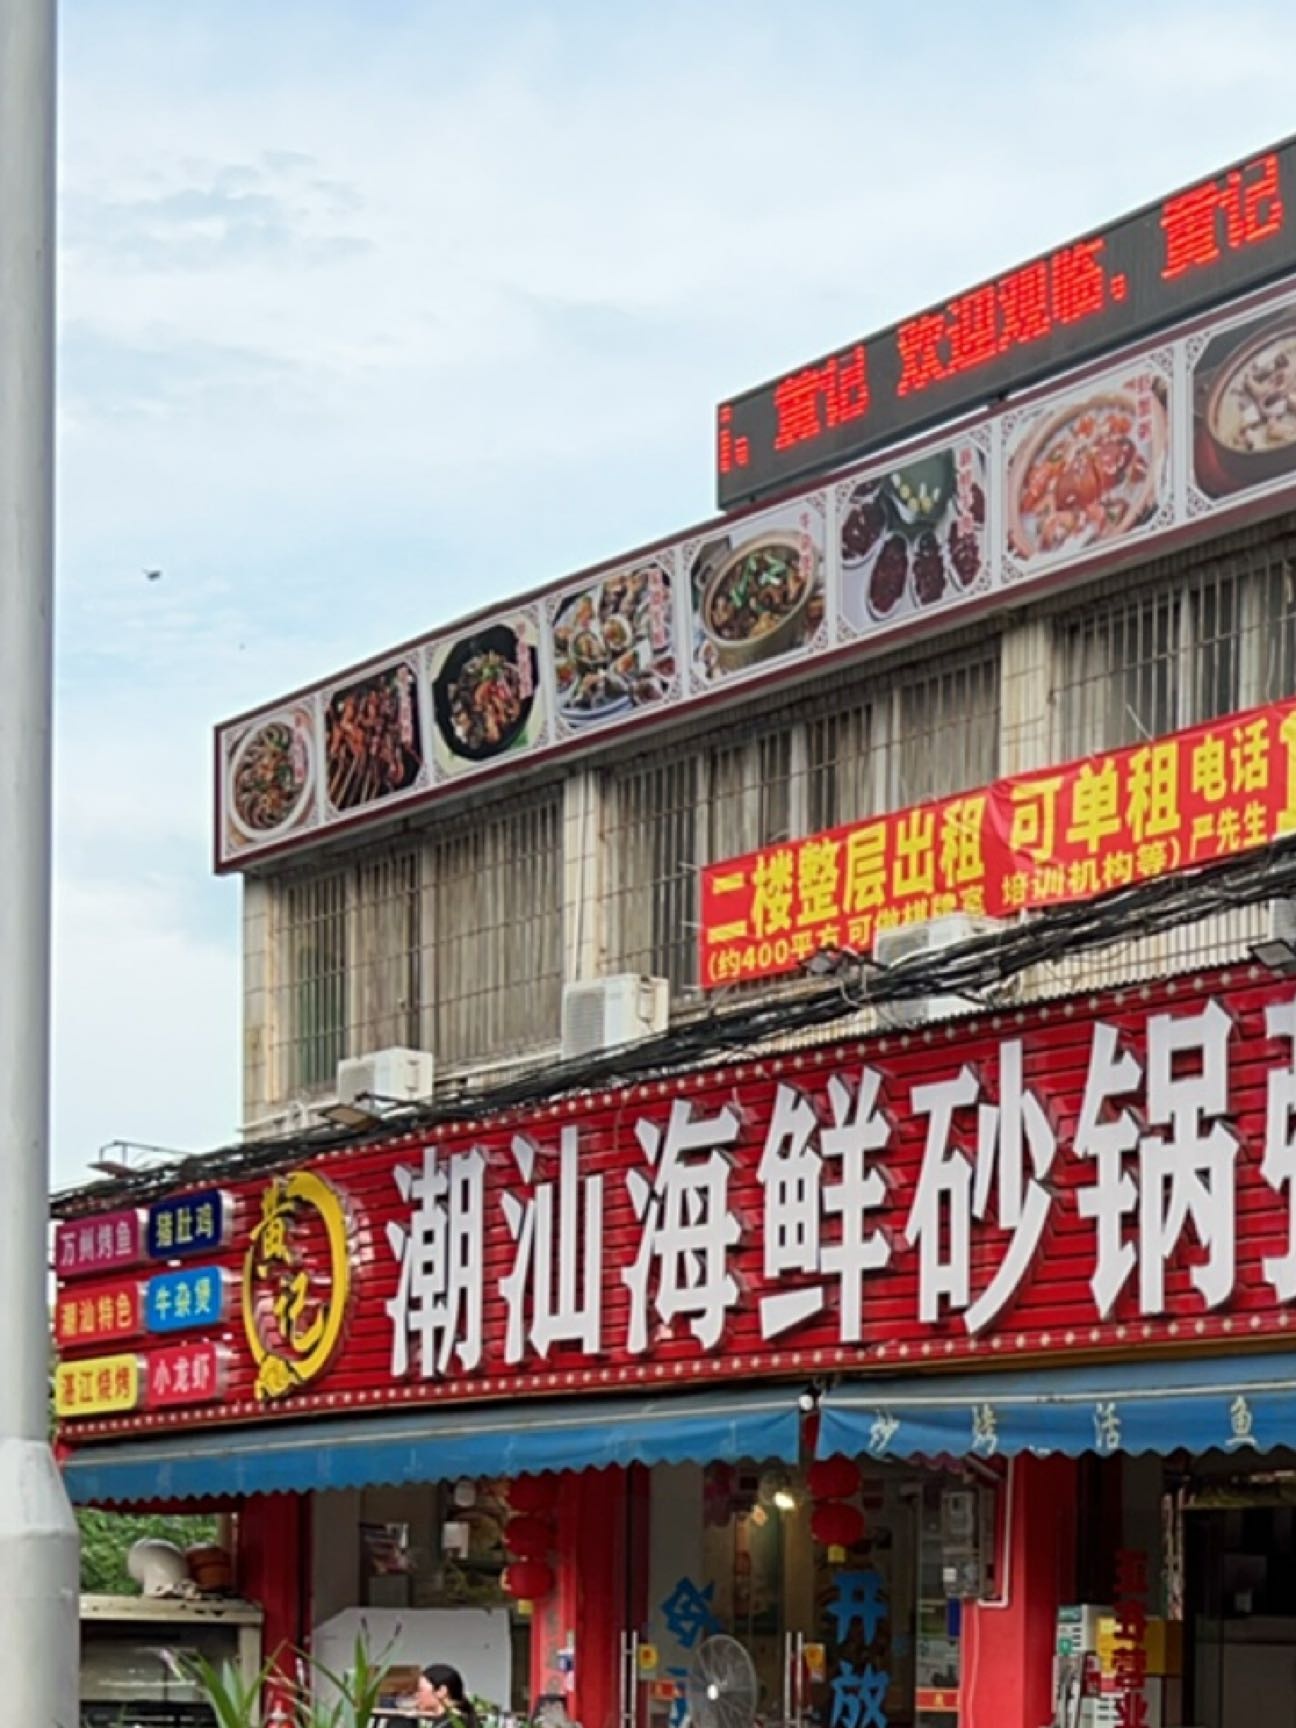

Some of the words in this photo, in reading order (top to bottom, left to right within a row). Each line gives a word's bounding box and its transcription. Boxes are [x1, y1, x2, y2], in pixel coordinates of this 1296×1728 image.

[706, 796, 986, 944] 二楼整层出租
[1009, 739, 1181, 865] 可单租
[1192, 718, 1270, 802] 电话
[1190, 800, 1269, 860] 严先生
[152, 1352, 211, 1395] 小龙虾
